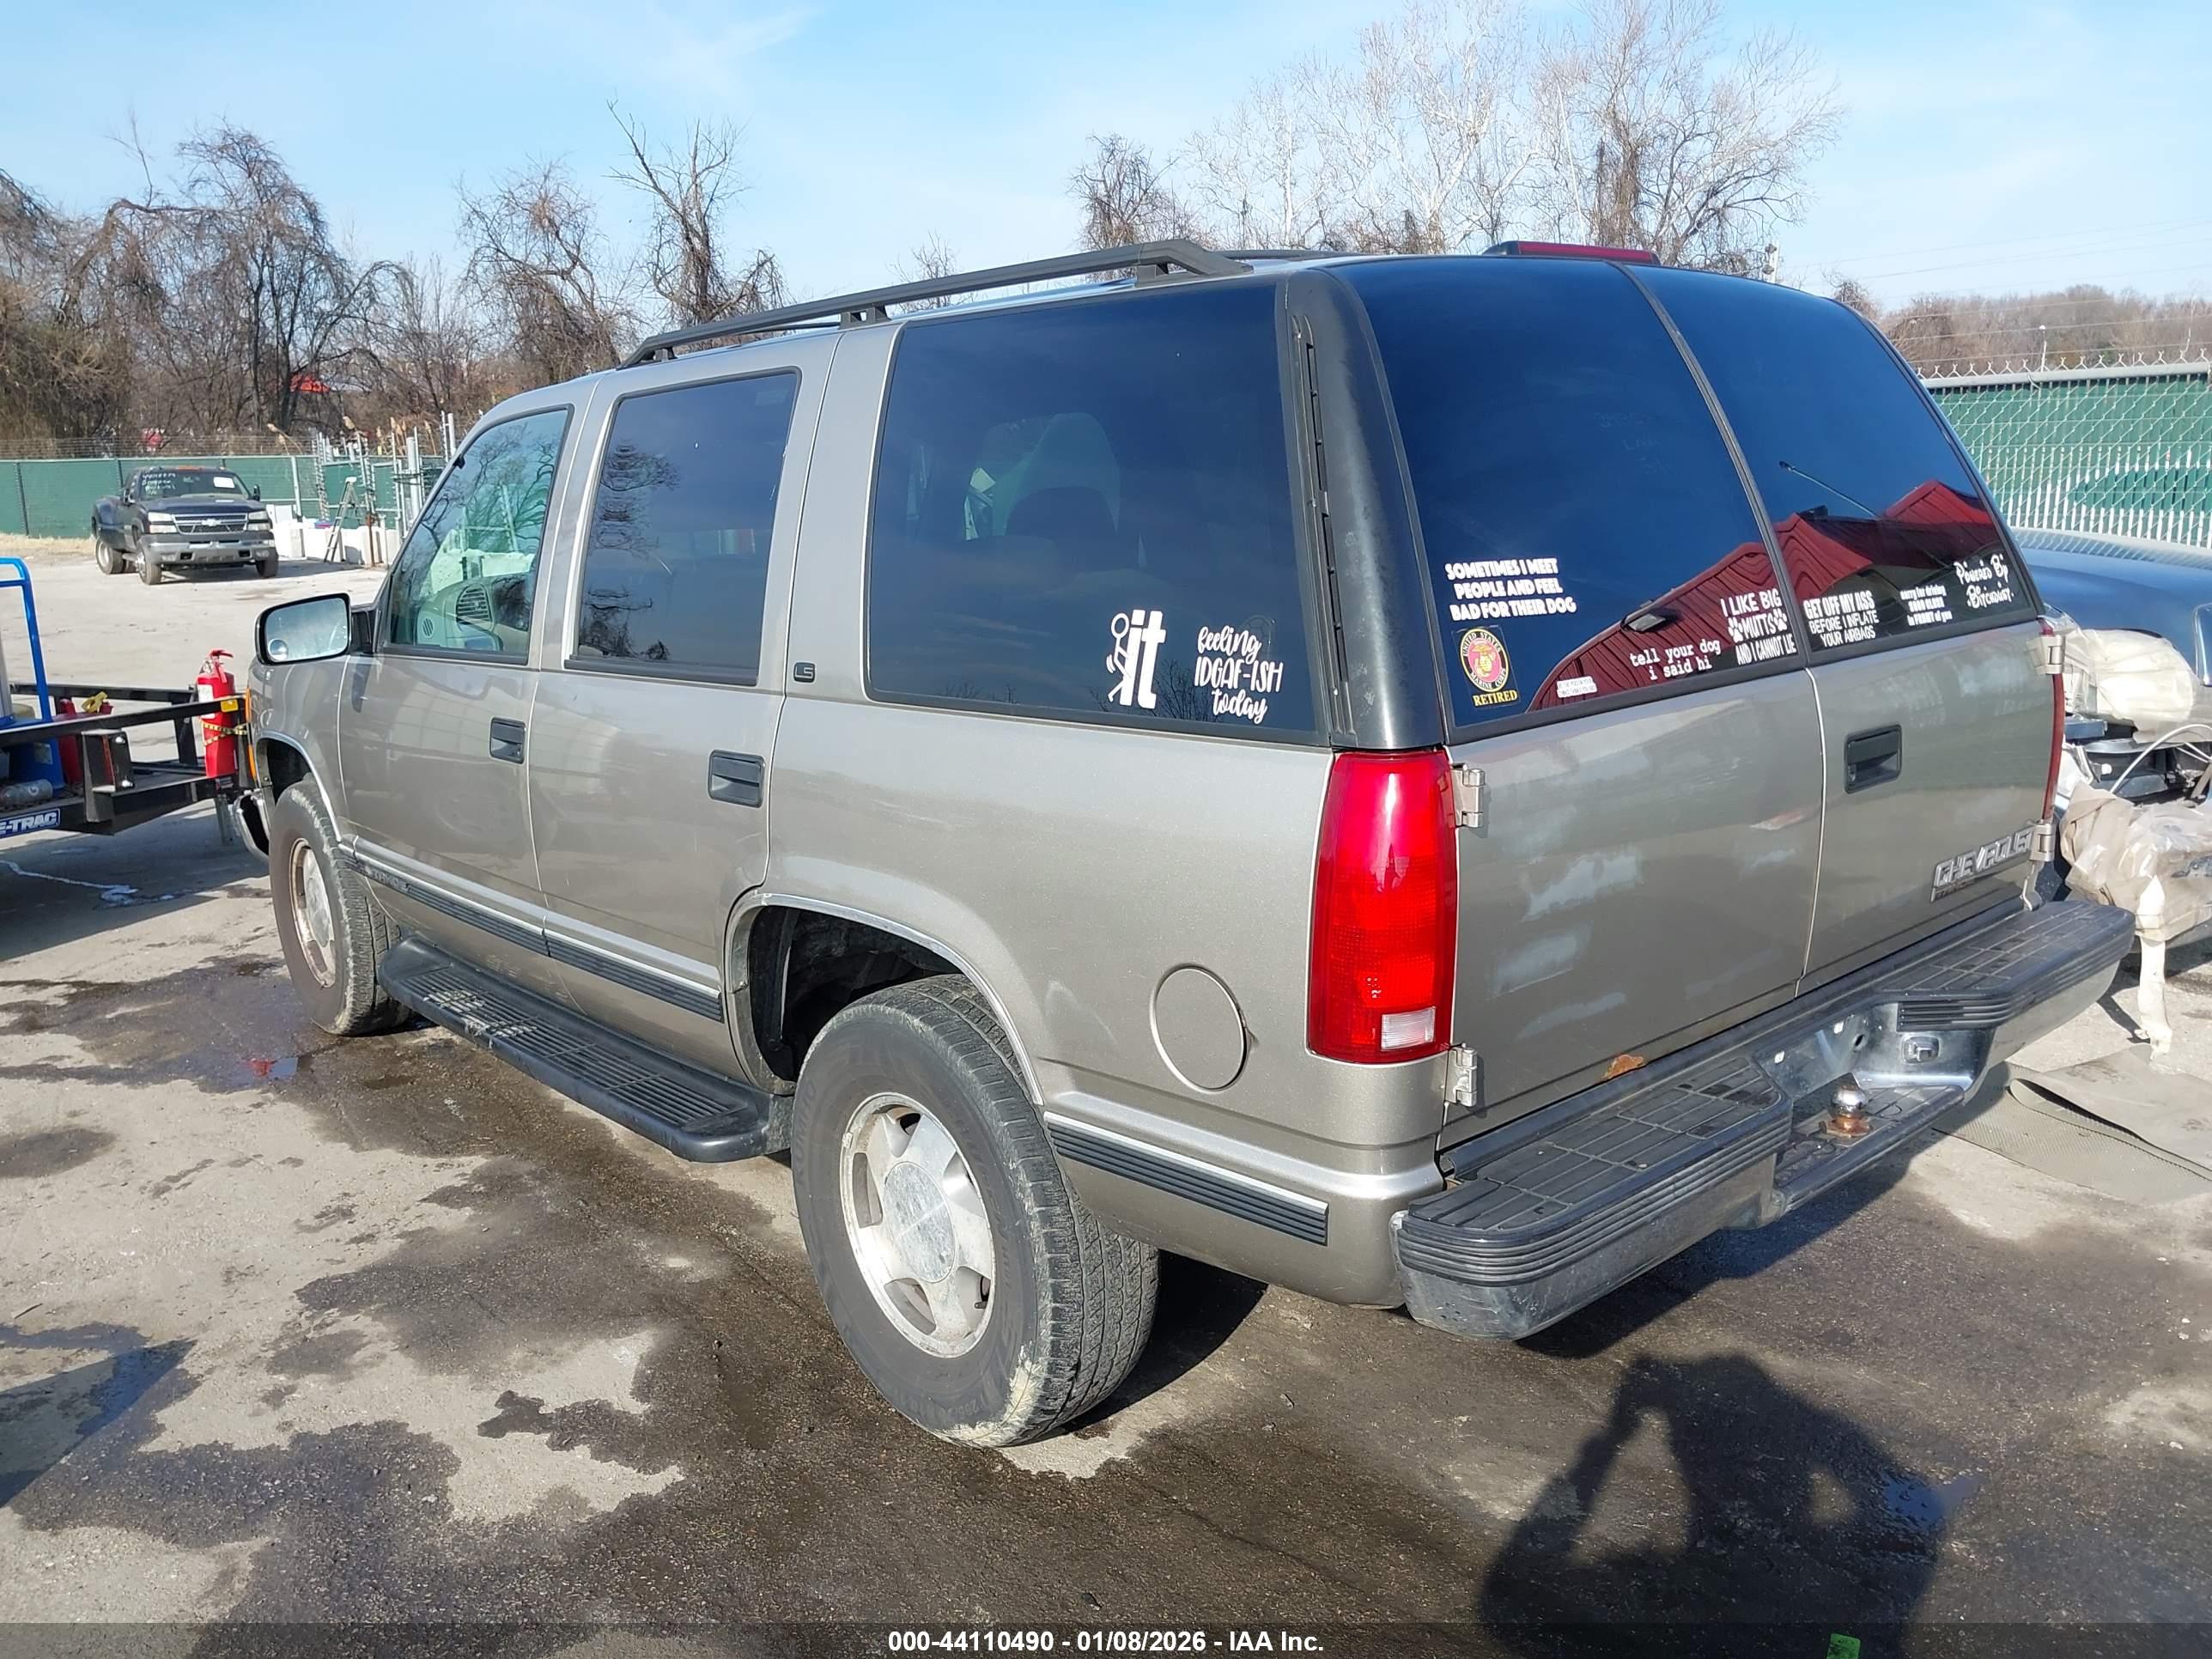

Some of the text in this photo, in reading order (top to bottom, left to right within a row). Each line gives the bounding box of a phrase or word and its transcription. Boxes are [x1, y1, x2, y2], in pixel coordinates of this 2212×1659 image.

[1445, 558, 1559, 580] SOMETIMES I MEET
[1454, 578, 1563, 599] PEOPLE AND FEEL
[1449, 597, 1577, 621] BAD FOR THEIR DOG
[1721, 588, 1782, 617] I LIKE BIG
[1803, 590, 1875, 619] GET OFF MY ASS
[1741, 613, 1776, 639] MUTTS
[1808, 610, 1879, 634] BEFORE I INFLATE
[1198, 625, 1261, 665] feeling
[1463, 632, 1502, 656] UNITED STATES
[1820, 625, 1875, 647] YOUR AIRBAGS
[1630, 639, 1721, 666] tell your dog
[1735, 634, 1796, 665] AND I CANNOT LIE
[794, 665, 814, 679] LS
[1194, 656, 1284, 693] IDGAF-ISH
[1470, 668, 1506, 689] MARINE CORPS
[1649, 655, 1712, 680] i said hi
[1212, 689, 1267, 724] today
[1473, 690, 1518, 706] RETIRED
